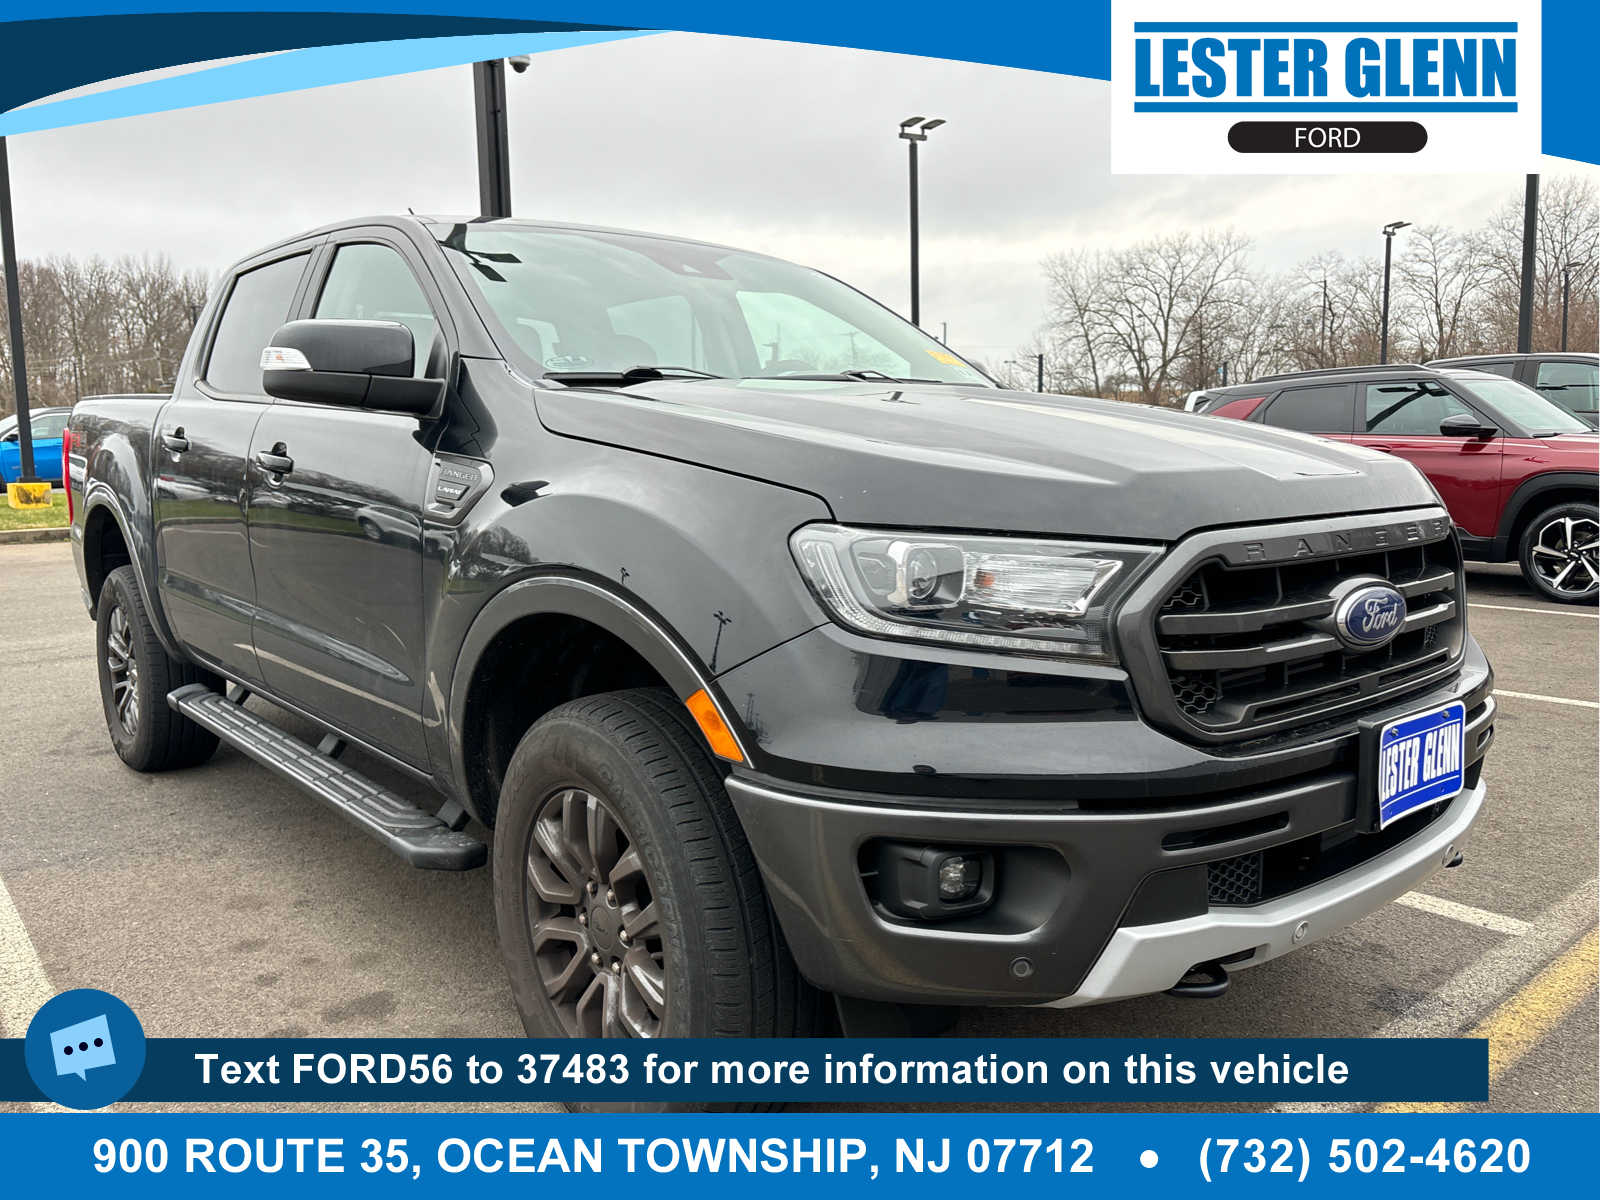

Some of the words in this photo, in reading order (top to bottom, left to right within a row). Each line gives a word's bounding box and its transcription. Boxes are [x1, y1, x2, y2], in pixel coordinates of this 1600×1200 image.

[1243, 518, 1447, 562] RANGER
[1362, 597, 1400, 633] Ford
[1381, 736, 1420, 802] LESTER
[1422, 722, 1461, 782] GLENN
